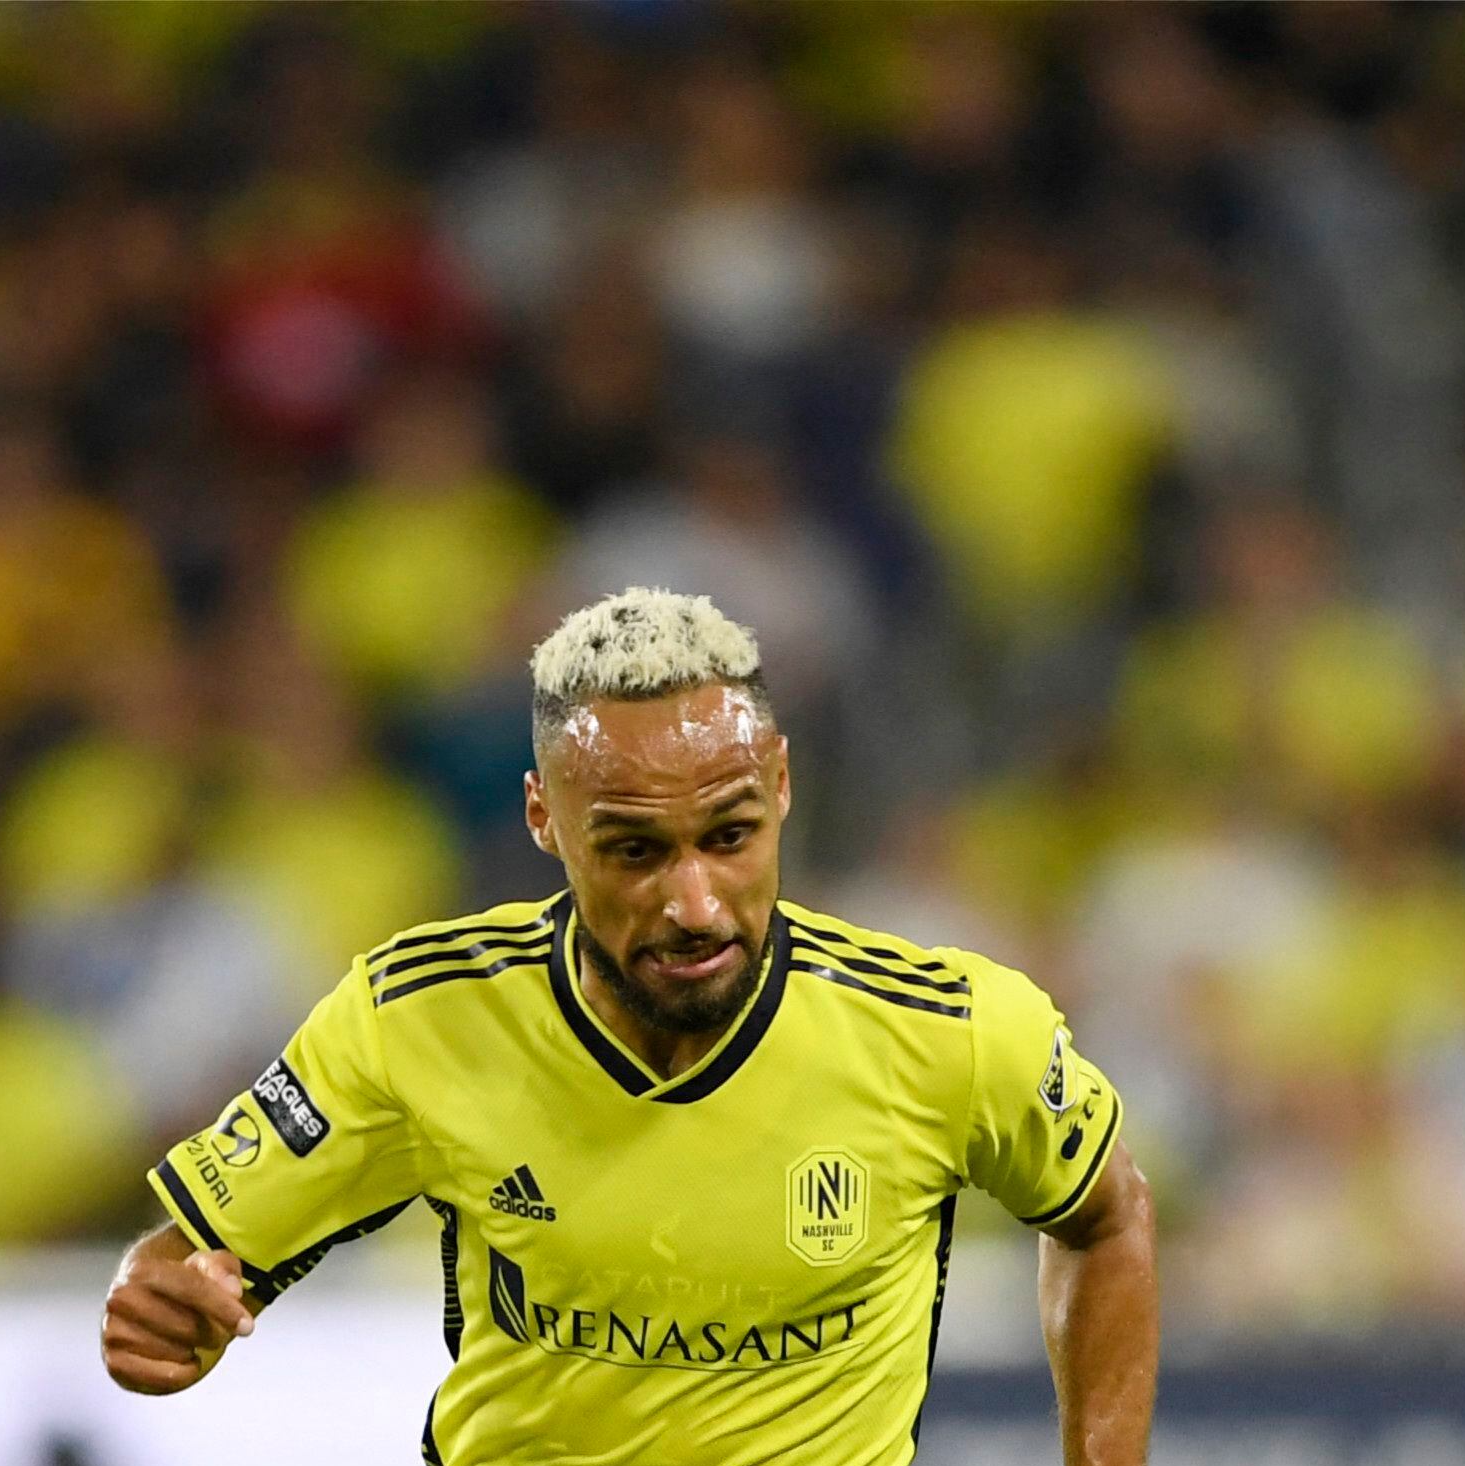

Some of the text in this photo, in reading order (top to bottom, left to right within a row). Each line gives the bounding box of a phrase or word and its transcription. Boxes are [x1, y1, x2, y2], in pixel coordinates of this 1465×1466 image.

[254, 1075, 280, 1103] UP
[266, 1061, 324, 1138] EAGUES
[488, 1195, 556, 1222] adidas
[802, 1223, 853, 1238] NASHVILLE
[822, 1239, 834, 1252] SC
[531, 1301, 867, 1364] RENASANT
